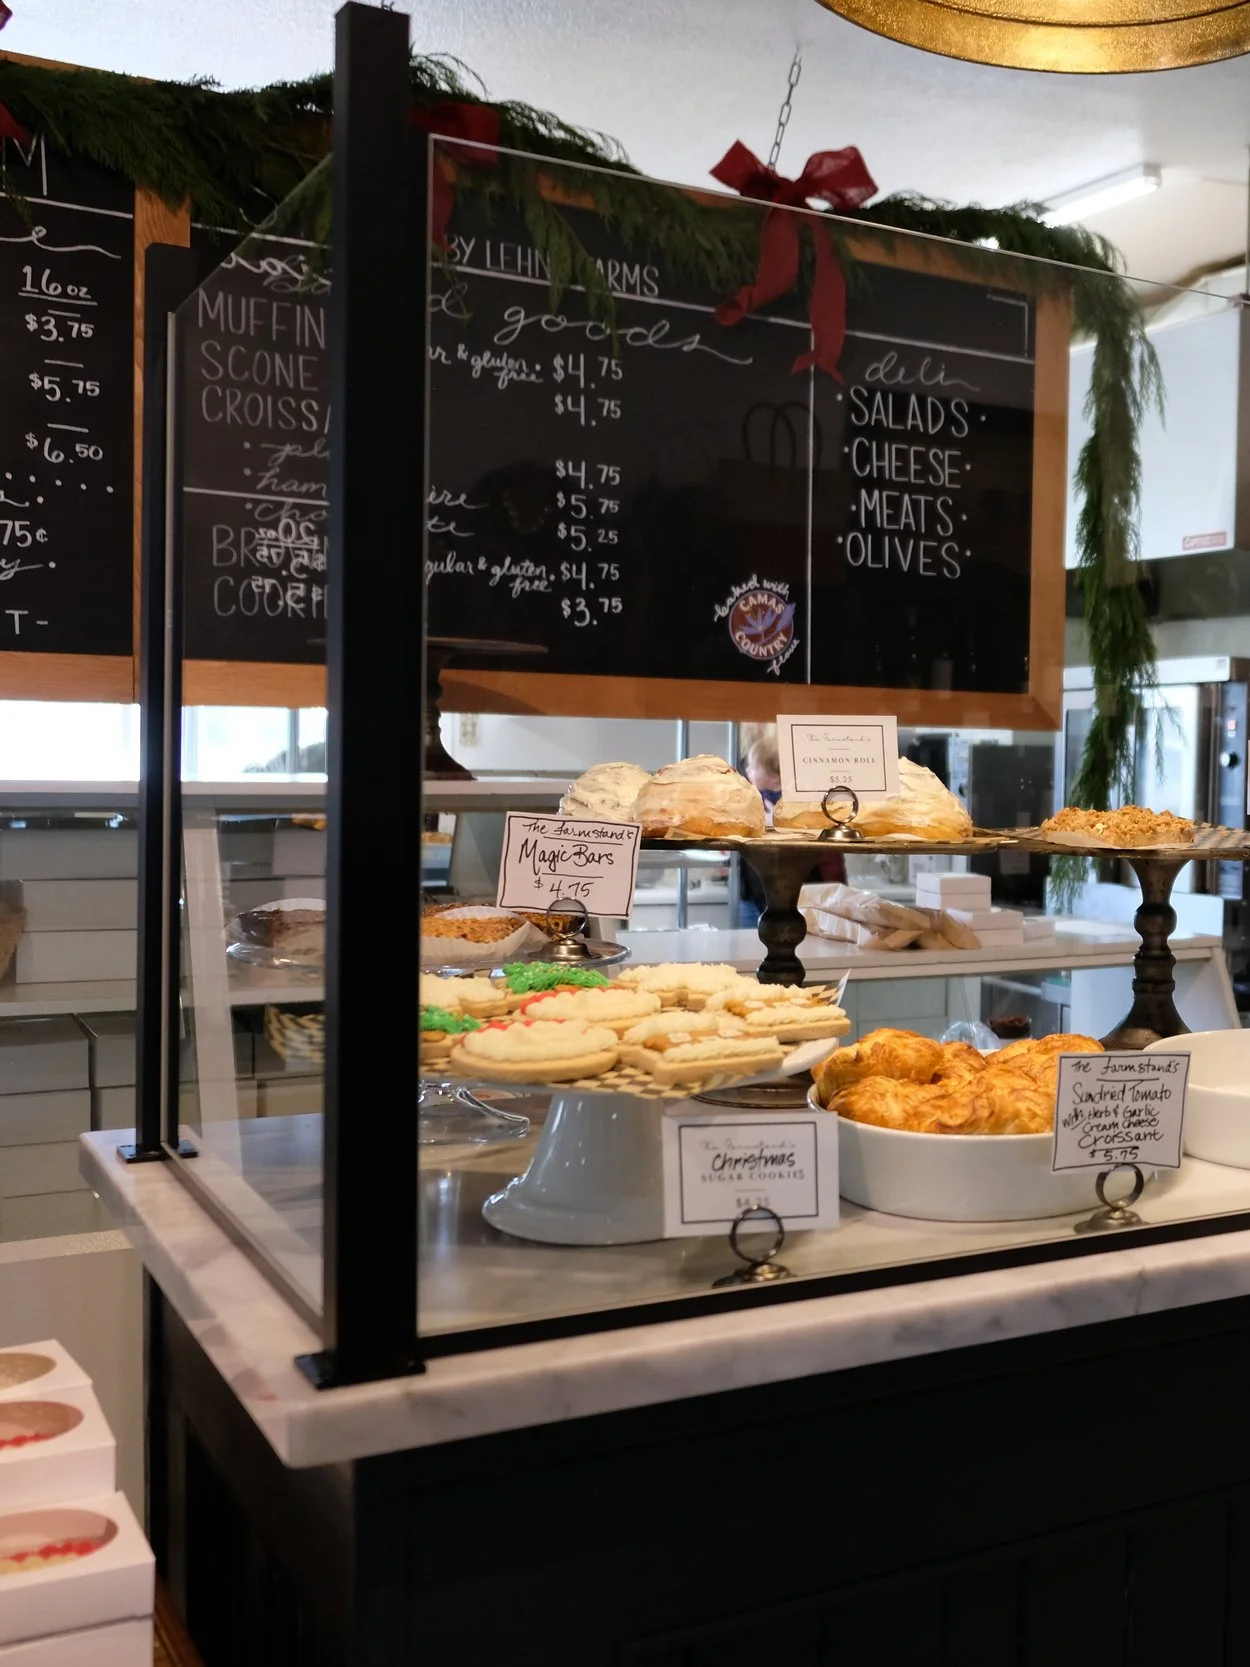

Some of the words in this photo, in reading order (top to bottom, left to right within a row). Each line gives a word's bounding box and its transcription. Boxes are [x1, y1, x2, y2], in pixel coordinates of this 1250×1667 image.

[24, 312, 95, 342] $3.75
[494, 306, 740, 362] goods
[471, 352, 528, 379] gluten
[553, 353, 623, 389] $4.75
[865, 351, 981, 392] deli
[28, 371, 100, 403] $5.75
[554, 393, 621, 427] $4.75
[850, 385, 969, 438] SALADS
[25, 431, 104, 464] $6.50
[851, 436, 962, 488] CHEESE
[555, 459, 622, 490] $4.75
[556, 490, 621, 521] $5.75
[860, 488, 954, 537] MEATS
[557, 521, 619, 552] $5.25
[845, 531, 961, 579] OLIVES
[489, 556, 547, 586] gluten
[560, 561, 620, 591] $4.75
[508, 576, 552, 598] free
[561, 597, 623, 627] $3.75
[739, 593, 785, 614] CAMAS
[735, 630, 788, 657] COUNTRY
[522, 819, 549, 834] The
[518, 838, 572, 876] Magic
[573, 843, 614, 867] Bars
[1128, 1079, 1172, 1103] Tomato
[1122, 1103, 1161, 1119] Garlic
[1077, 1130, 1165, 1150] Croissant
[711, 1148, 797, 1172] Christmas
